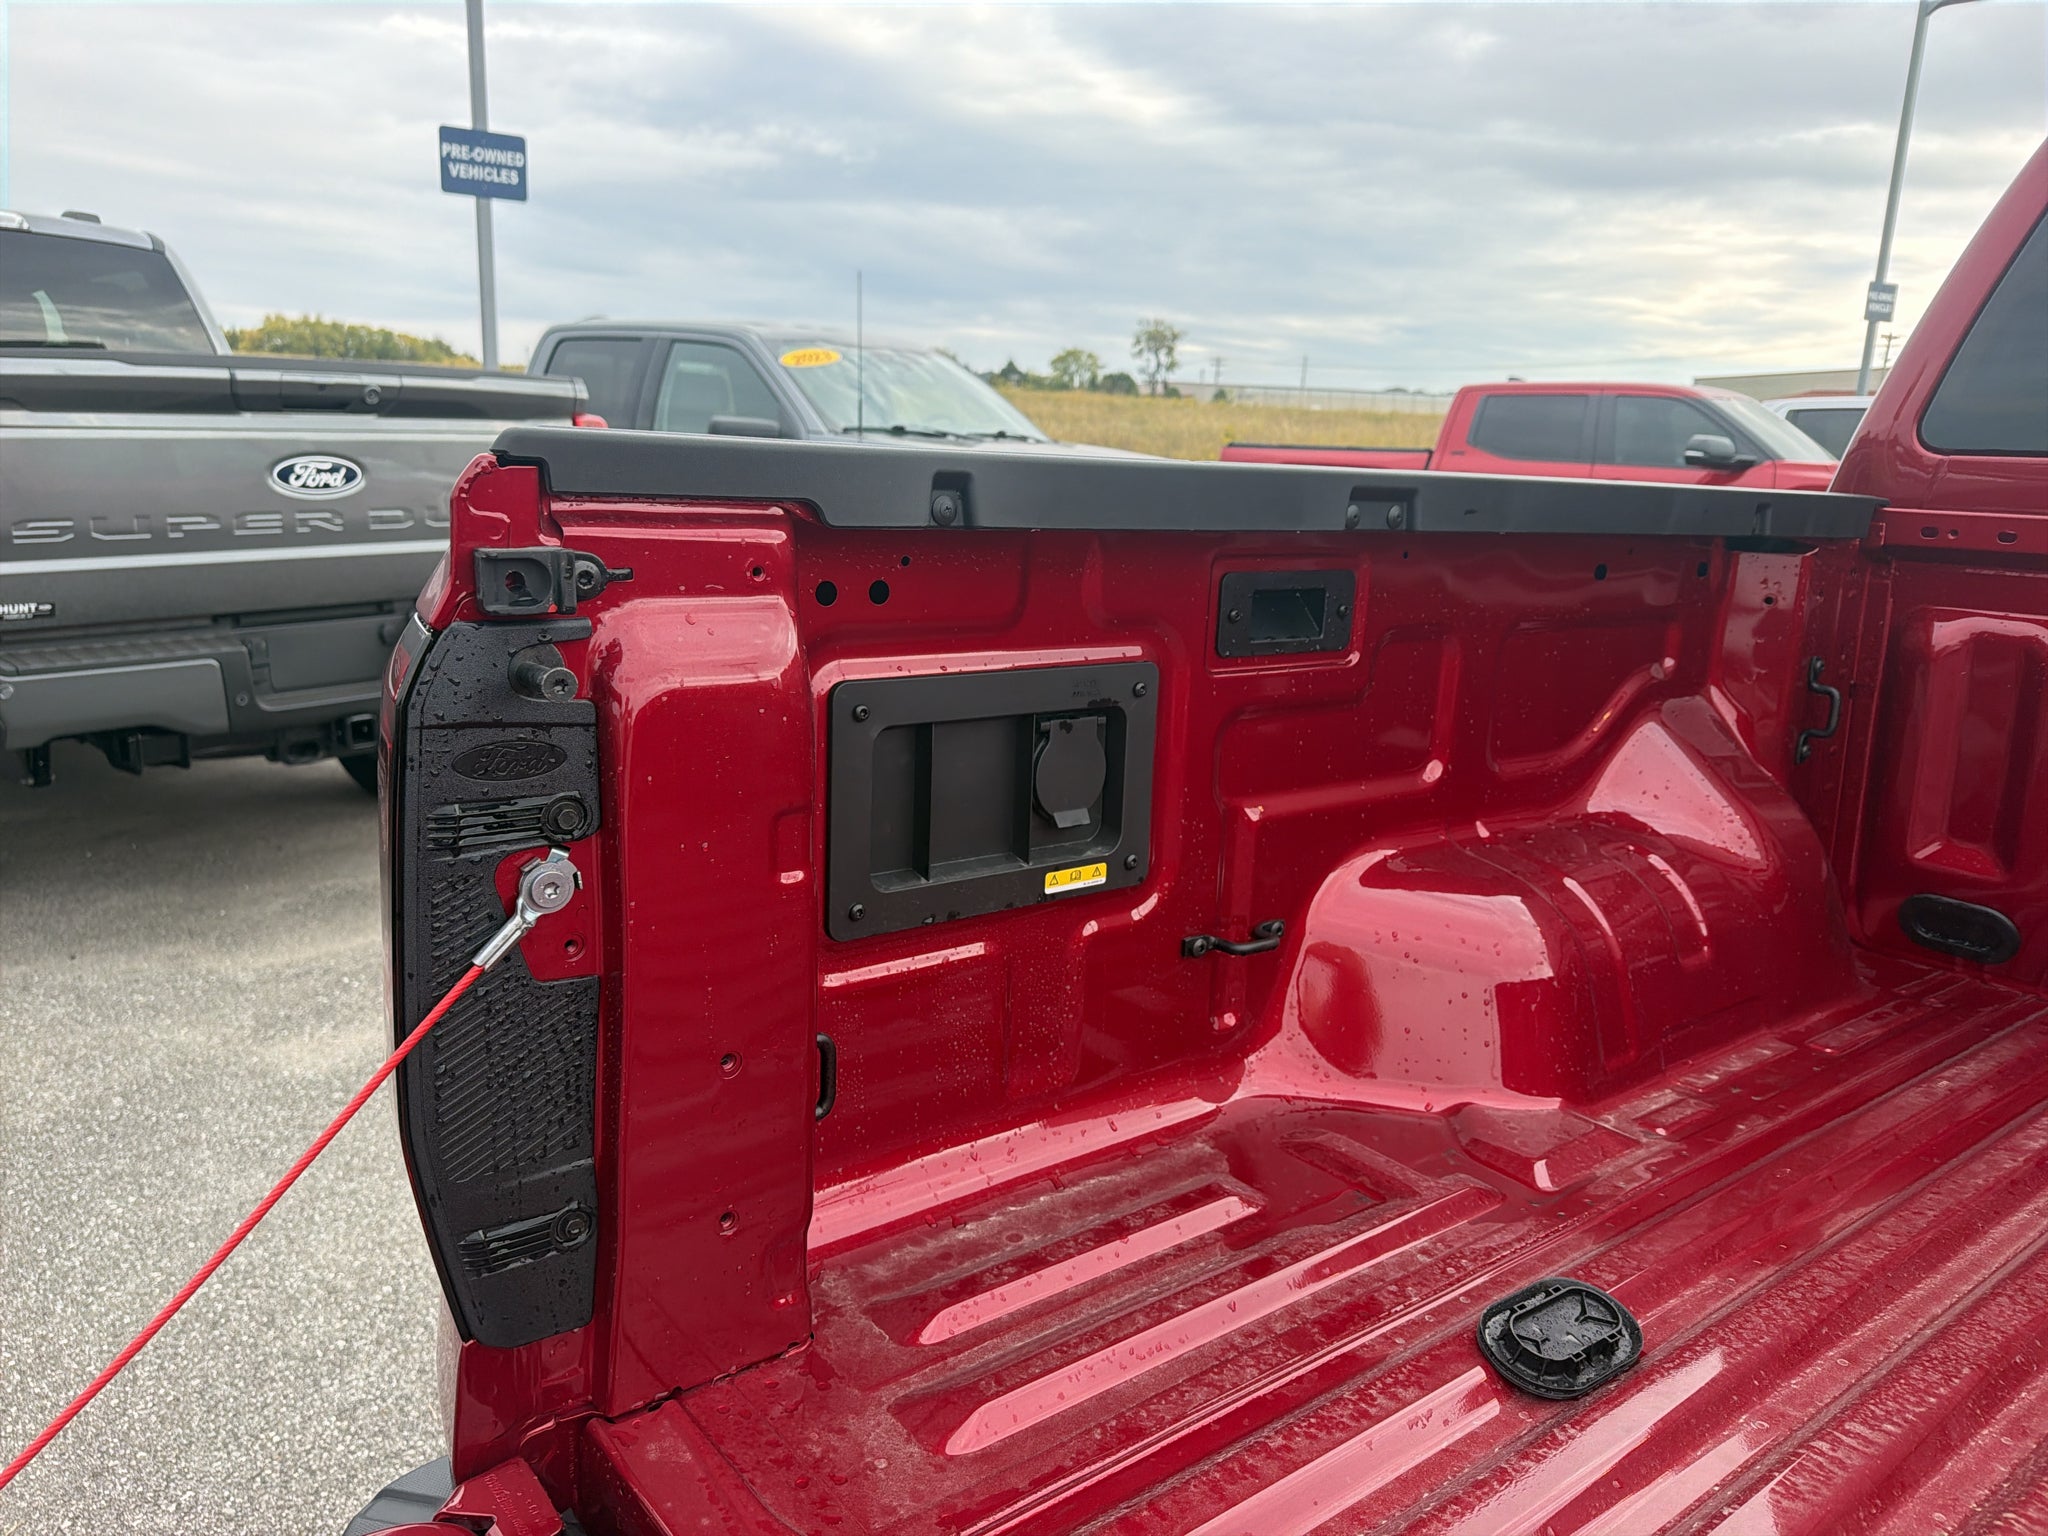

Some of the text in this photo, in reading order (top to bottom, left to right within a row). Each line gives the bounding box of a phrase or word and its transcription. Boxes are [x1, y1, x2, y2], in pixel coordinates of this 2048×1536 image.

[441, 142, 525, 168] PRE-OWNED
[448, 161, 519, 185] VEHICLES
[288, 461, 347, 488] Ford
[11, 509, 344, 544] SUPER
[473, 746, 550, 777] Ford
